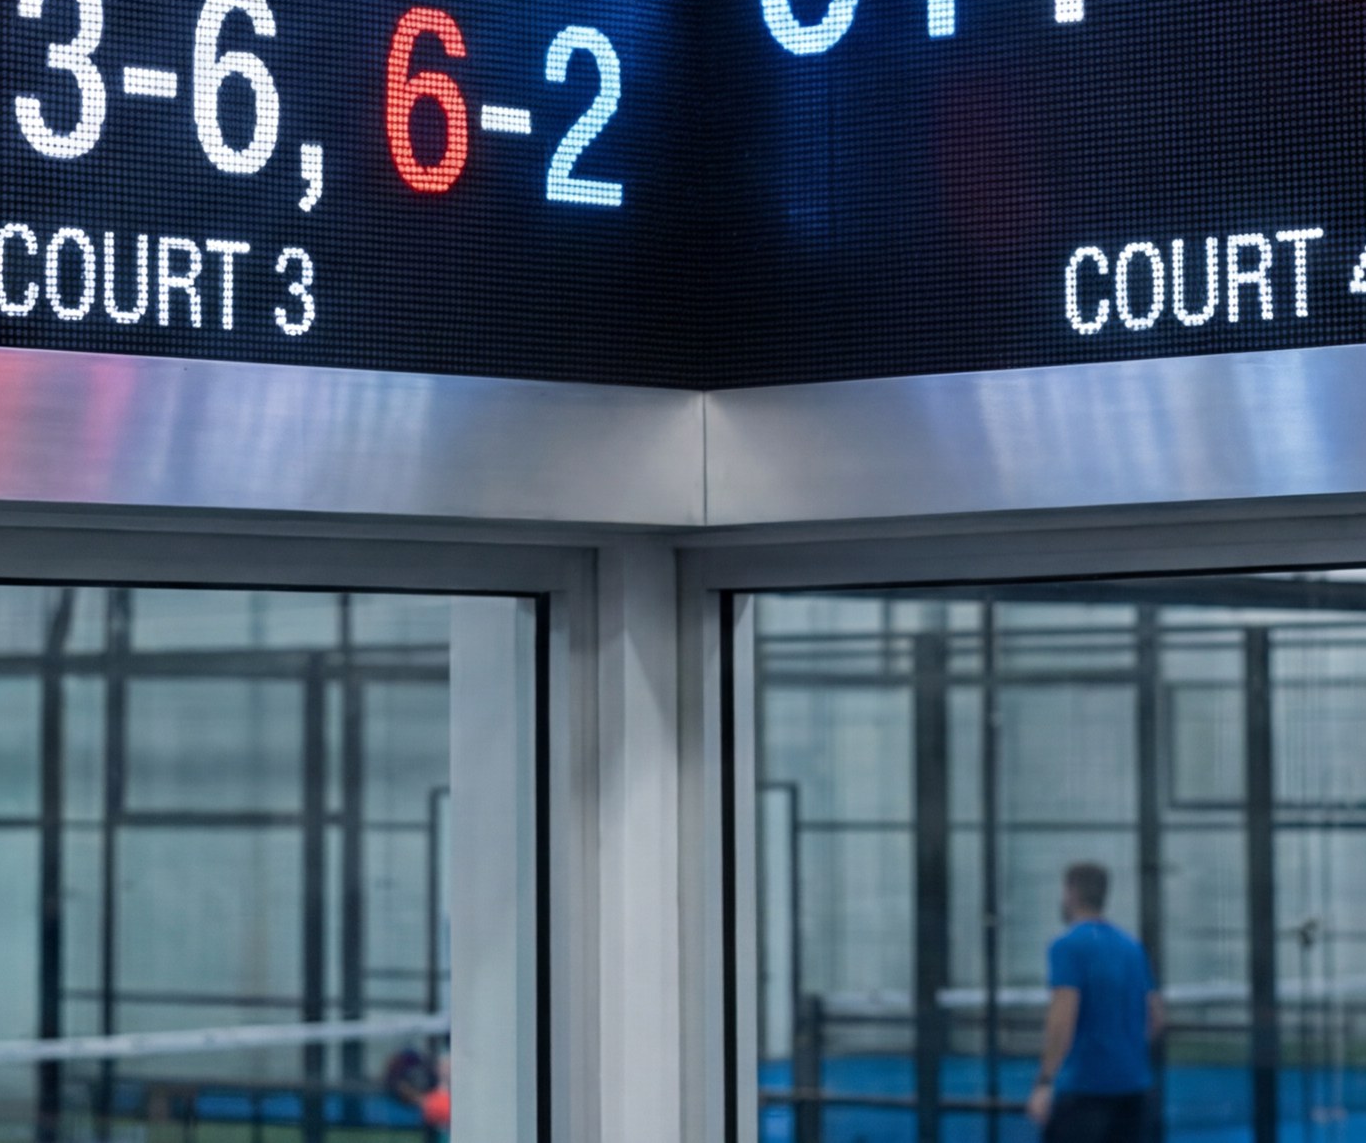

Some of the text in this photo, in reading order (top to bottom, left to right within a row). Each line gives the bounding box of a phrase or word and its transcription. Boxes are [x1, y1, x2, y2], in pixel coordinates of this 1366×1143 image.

[384, 6, 640, 209] 6-2
[272, 245, 317, 338] 3
[1063, 225, 1325, 336] COURT
